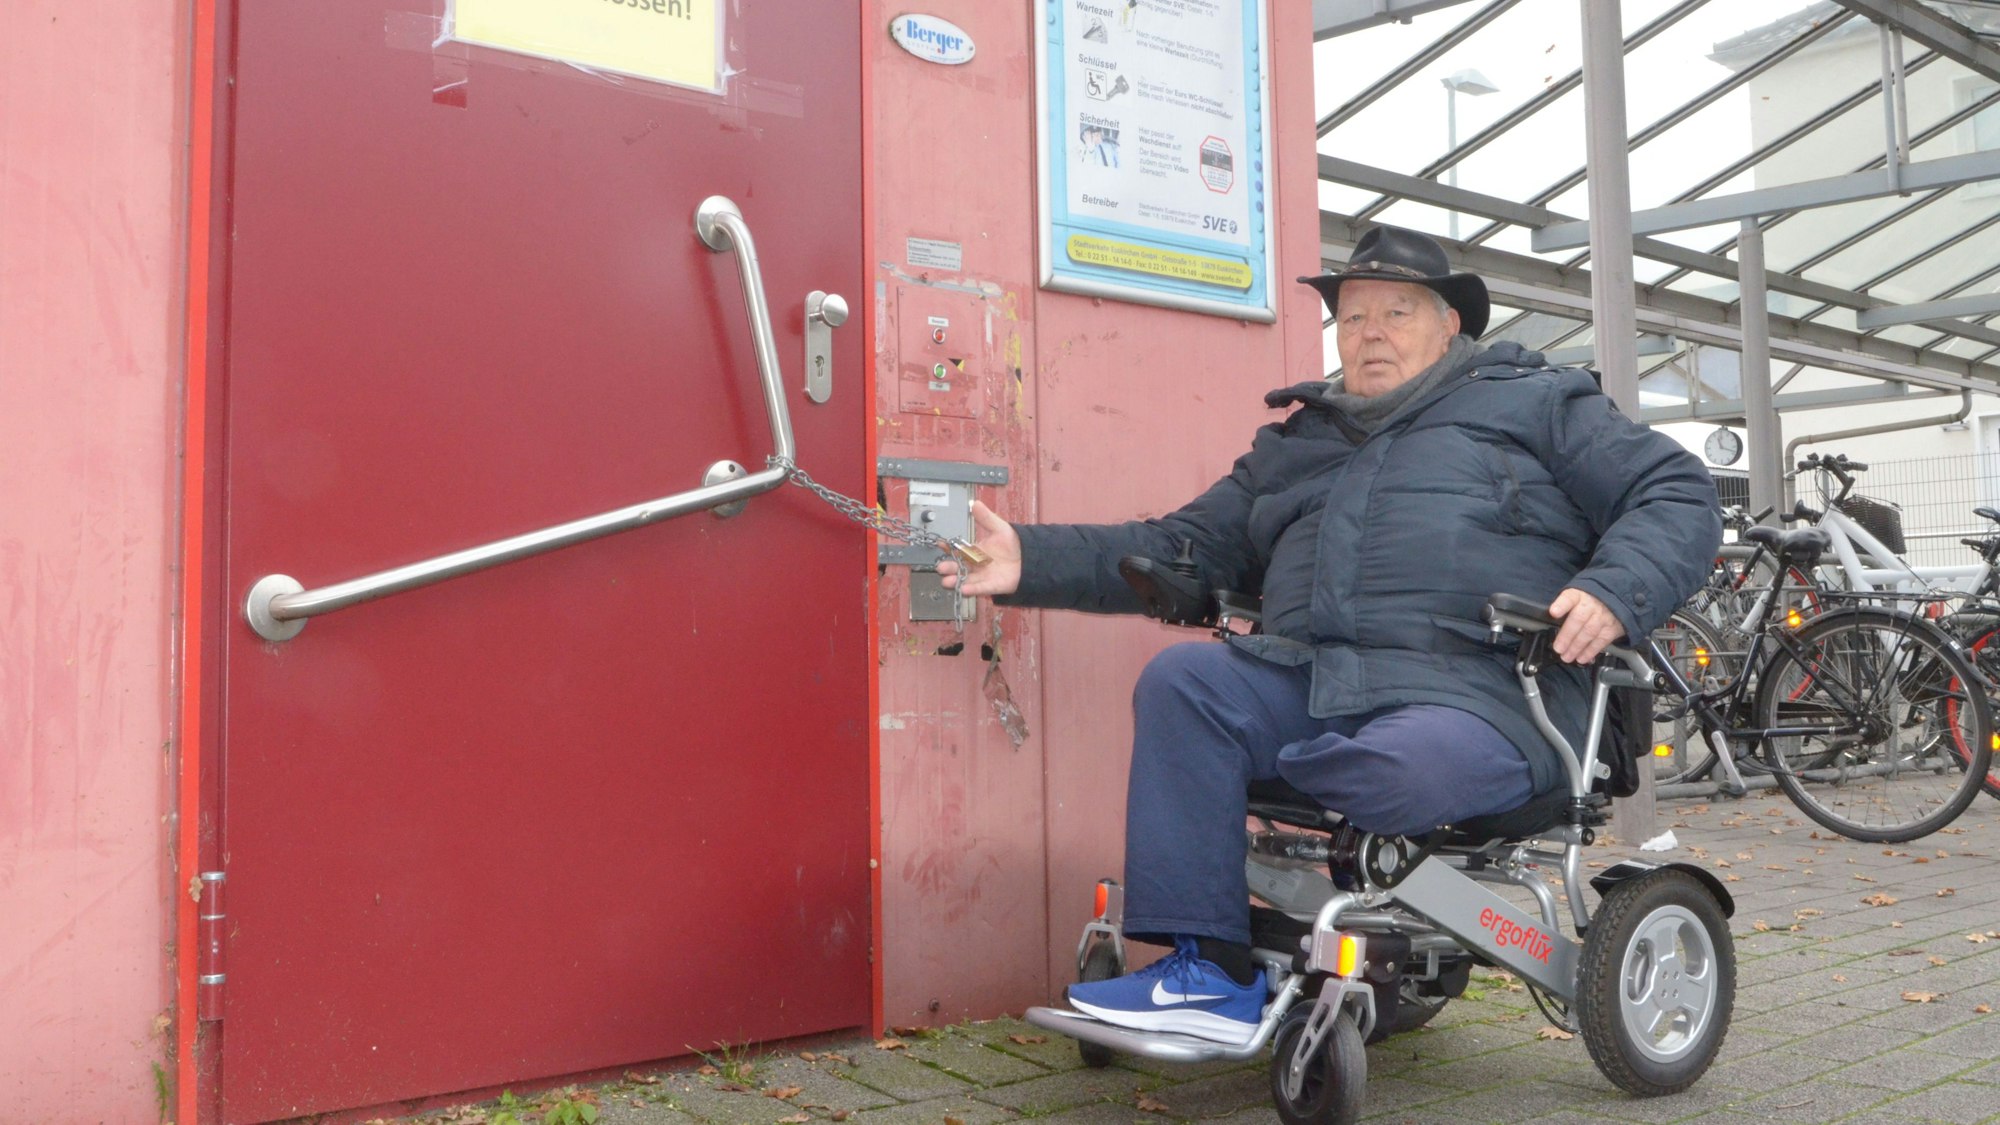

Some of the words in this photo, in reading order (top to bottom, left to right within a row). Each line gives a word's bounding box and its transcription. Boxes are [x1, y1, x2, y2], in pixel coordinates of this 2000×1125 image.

[1076, 1, 1113, 17] Wartezeit
[907, 19, 963, 54] Berger
[1079, 53, 1117, 70] Schlüssel
[1080, 112, 1120, 128] Sicherheit
[1174, 164, 1189, 174] Video
[1082, 194, 1119, 208] Betreiber
[1203, 215, 1228, 232] SVE
[1480, 907, 1554, 965] ergoflix
